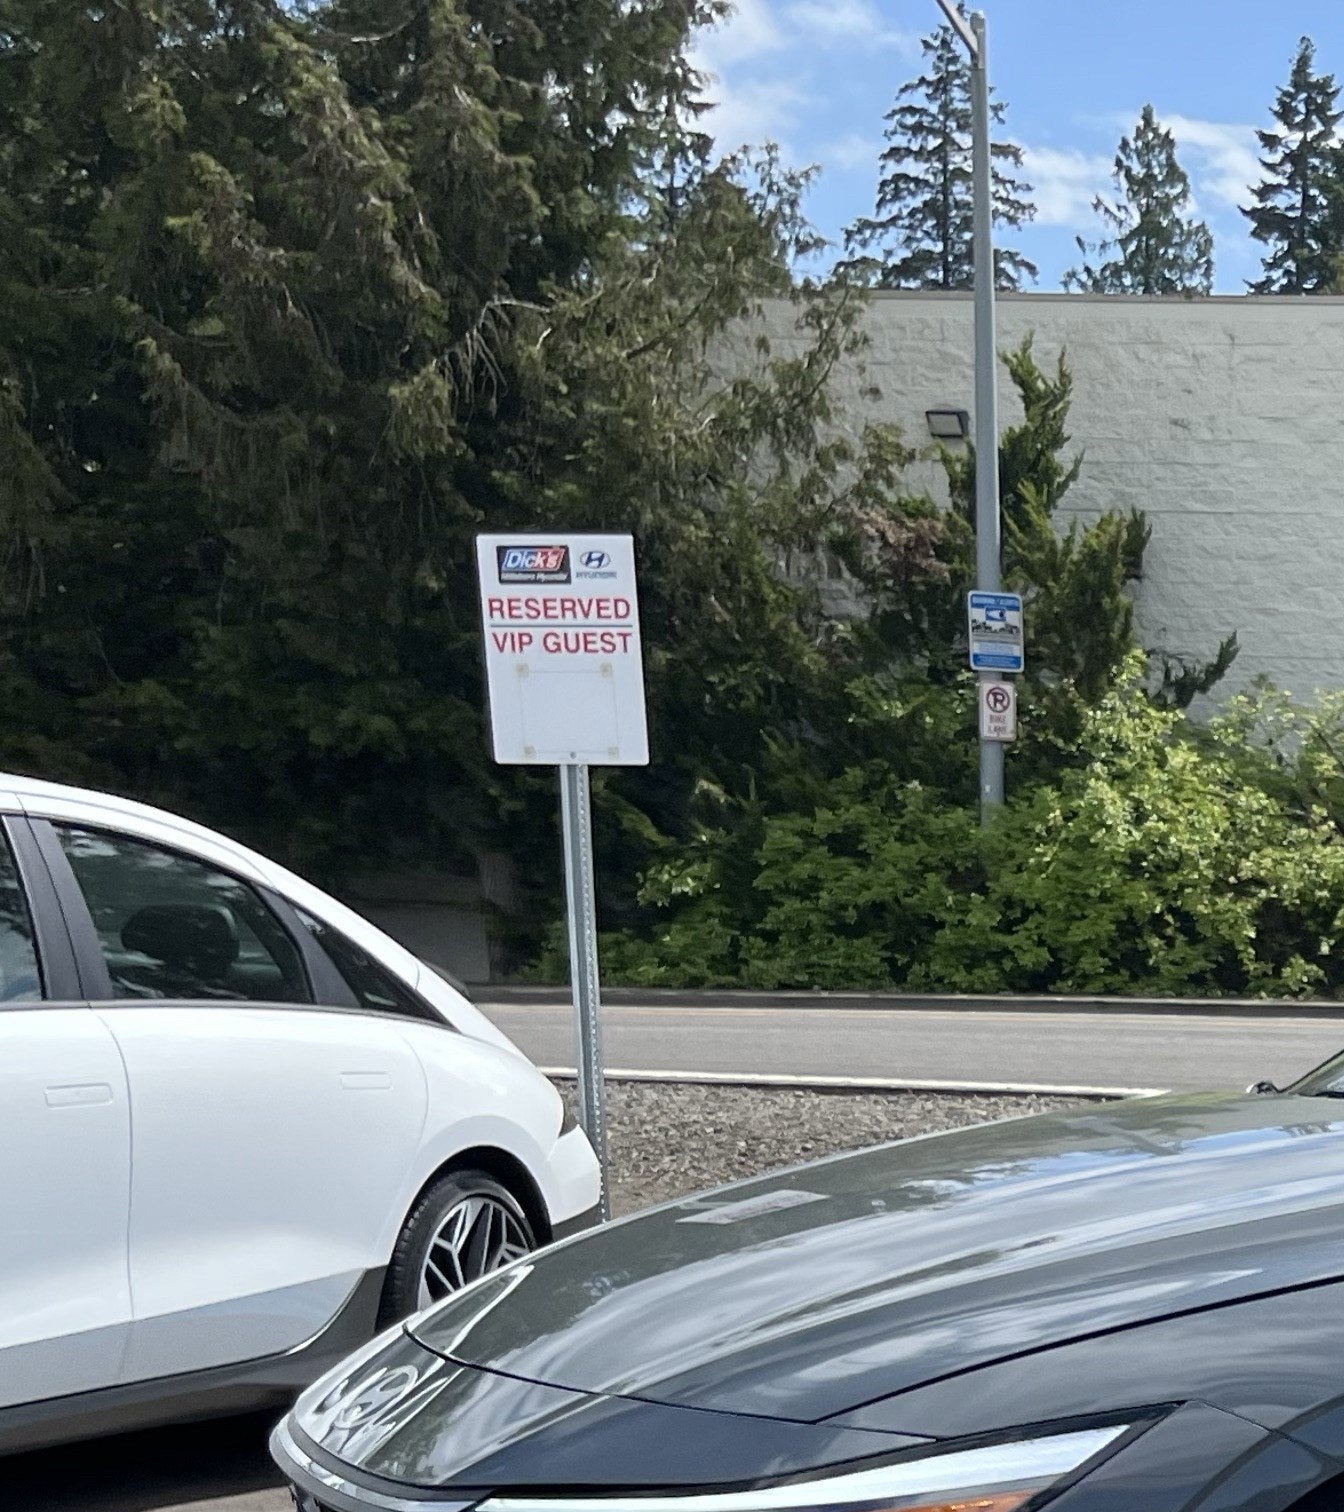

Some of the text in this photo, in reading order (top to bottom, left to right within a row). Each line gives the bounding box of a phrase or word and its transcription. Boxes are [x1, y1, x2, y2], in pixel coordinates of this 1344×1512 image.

[488, 597, 631, 620] RESERVED
[491, 632, 632, 654] VIP GUEST
